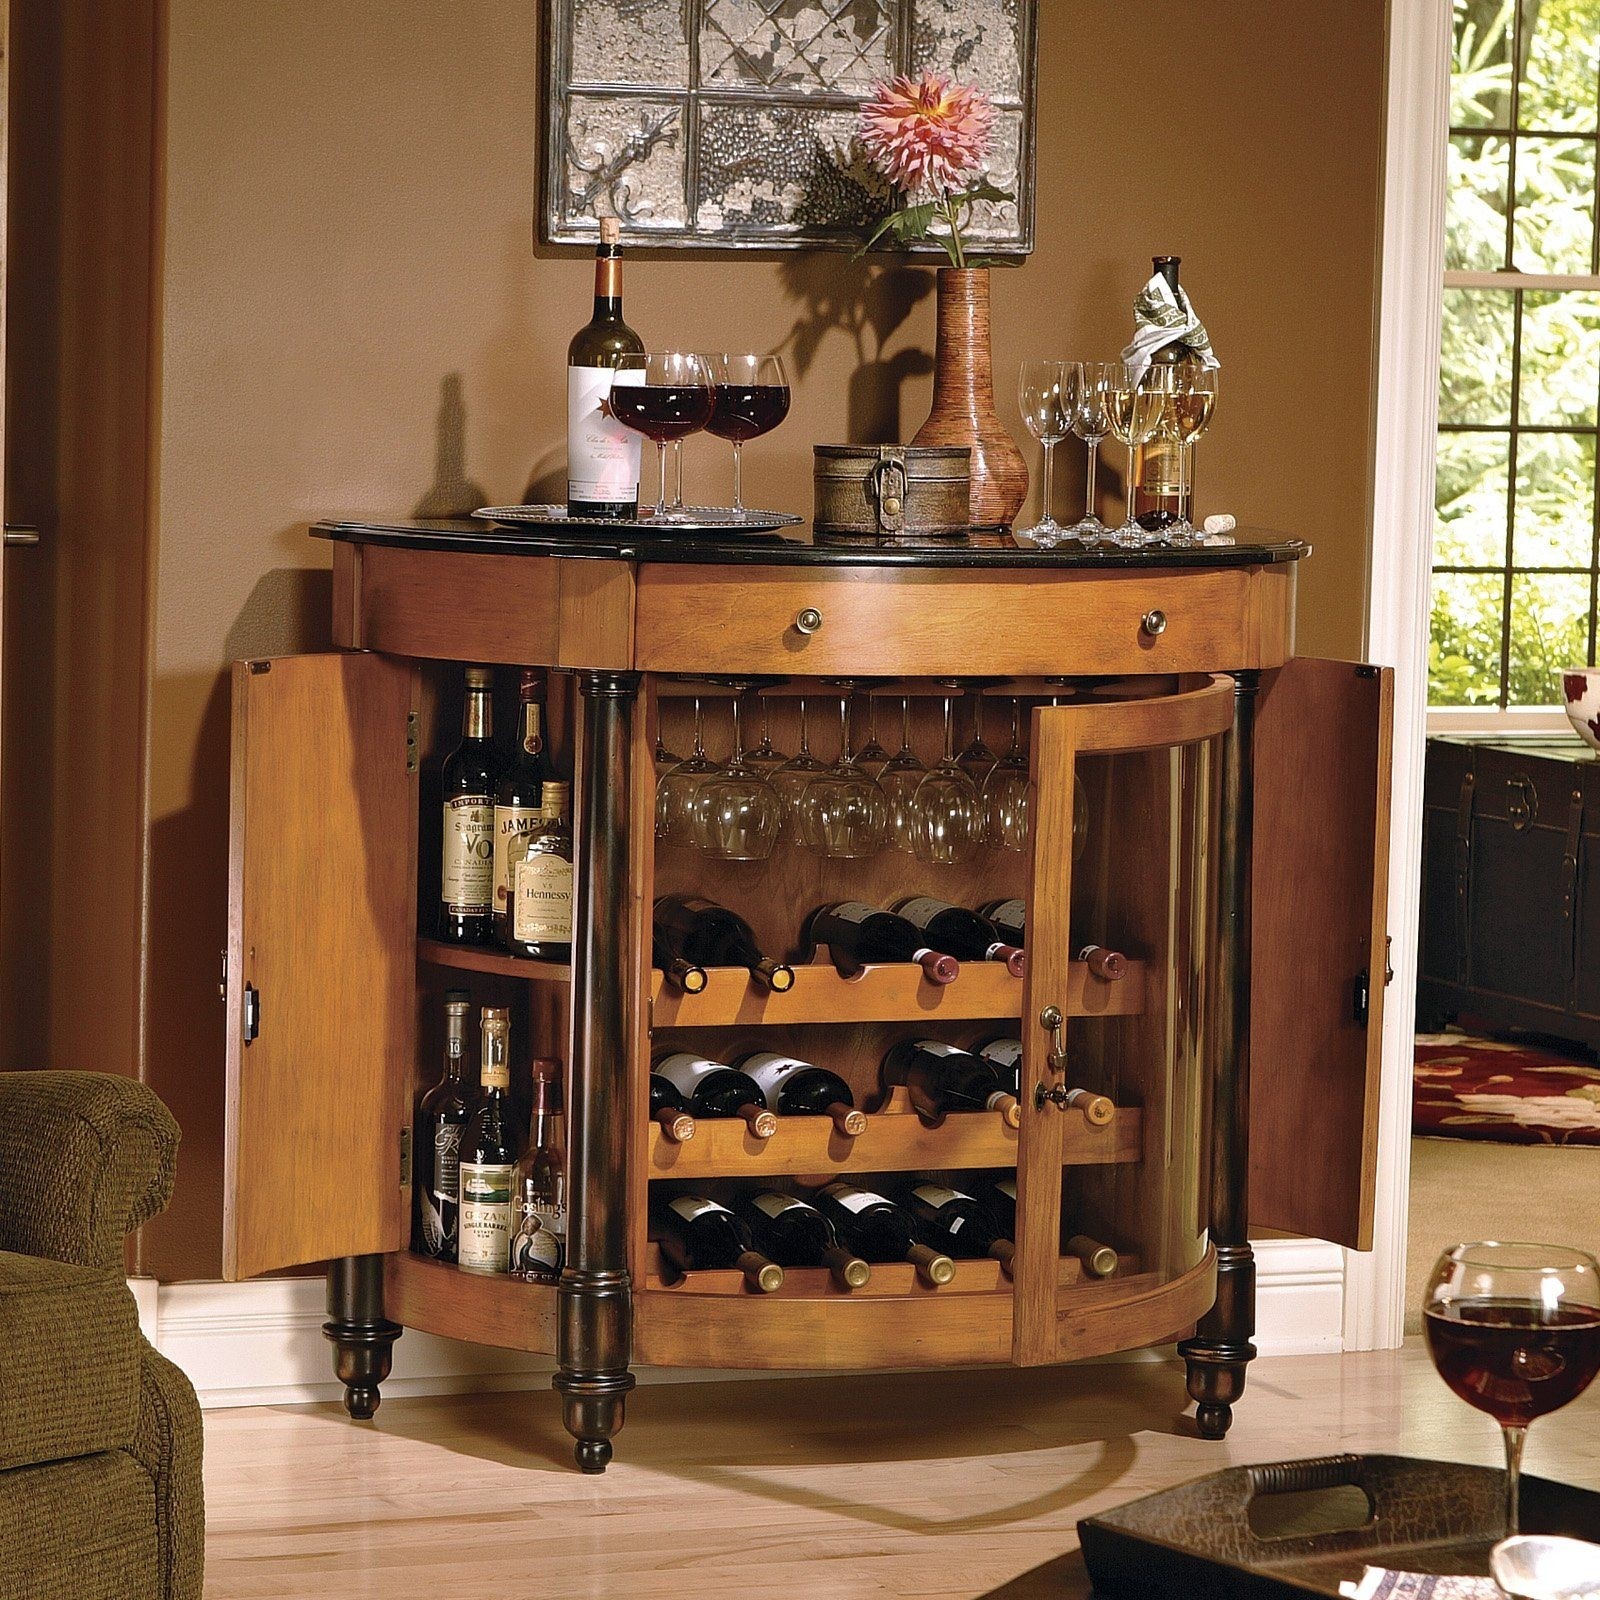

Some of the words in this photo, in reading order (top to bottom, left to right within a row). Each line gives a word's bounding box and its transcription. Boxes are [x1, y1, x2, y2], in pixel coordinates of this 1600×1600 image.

[455, 822, 494, 833] Sagram
[501, 817, 543, 834] JAME
[465, 833, 493, 859] VO
[526, 888, 571, 901] Hennessy
[465, 1210, 506, 1221] CRZAN
